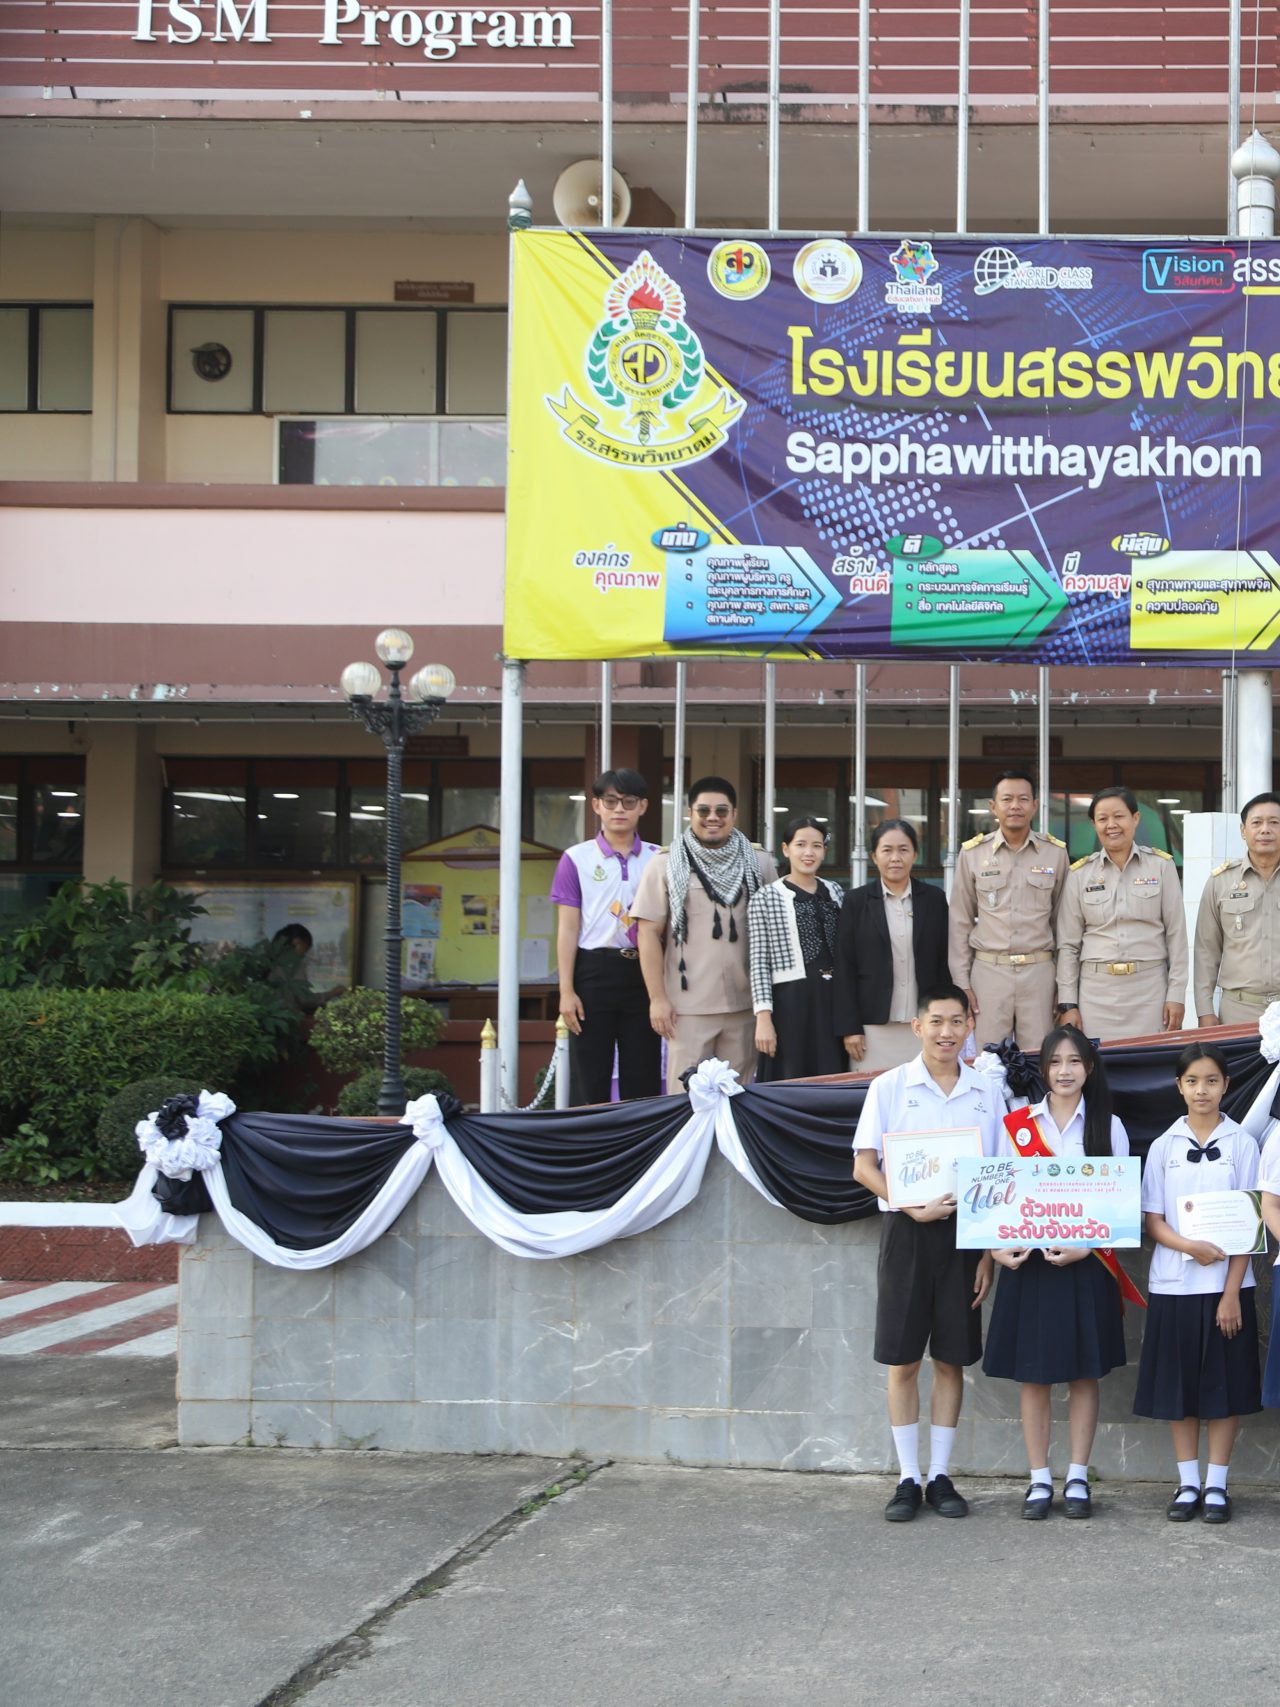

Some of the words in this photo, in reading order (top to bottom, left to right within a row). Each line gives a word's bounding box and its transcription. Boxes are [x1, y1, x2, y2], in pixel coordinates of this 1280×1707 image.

[131, 0, 273, 44] ISM
[318, 0, 575, 61] Program
[1149, 256, 1224, 286] Vision
[888, 284, 940, 296] Thailand
[576, 429, 718, 463] ร.ร.สรรพวิทยาคม
[786, 432, 1261, 488] Sapphawitthayakhom
[575, 545, 629, 567] องค์กร
[834, 549, 875, 573] สร้าง
[1066, 554, 1077, 573] มี
[595, 570, 659, 591] คุณภาพ
[852, 573, 888, 592] คนดี
[1065, 574, 1130, 596] ความสุข
[1147, 599, 1218, 613] ความปลอดภัย
[971, 1173, 1004, 1184] NUMBER
[979, 1165, 995, 1175] TO
[997, 1162, 1013, 1172] BE
[995, 1177, 1010, 1185] ONE
[964, 1182, 1016, 1214] Idol
[1020, 1197, 1082, 1217] ตัวแทน
[998, 1219, 1110, 1239] ระดับจังหวัด
